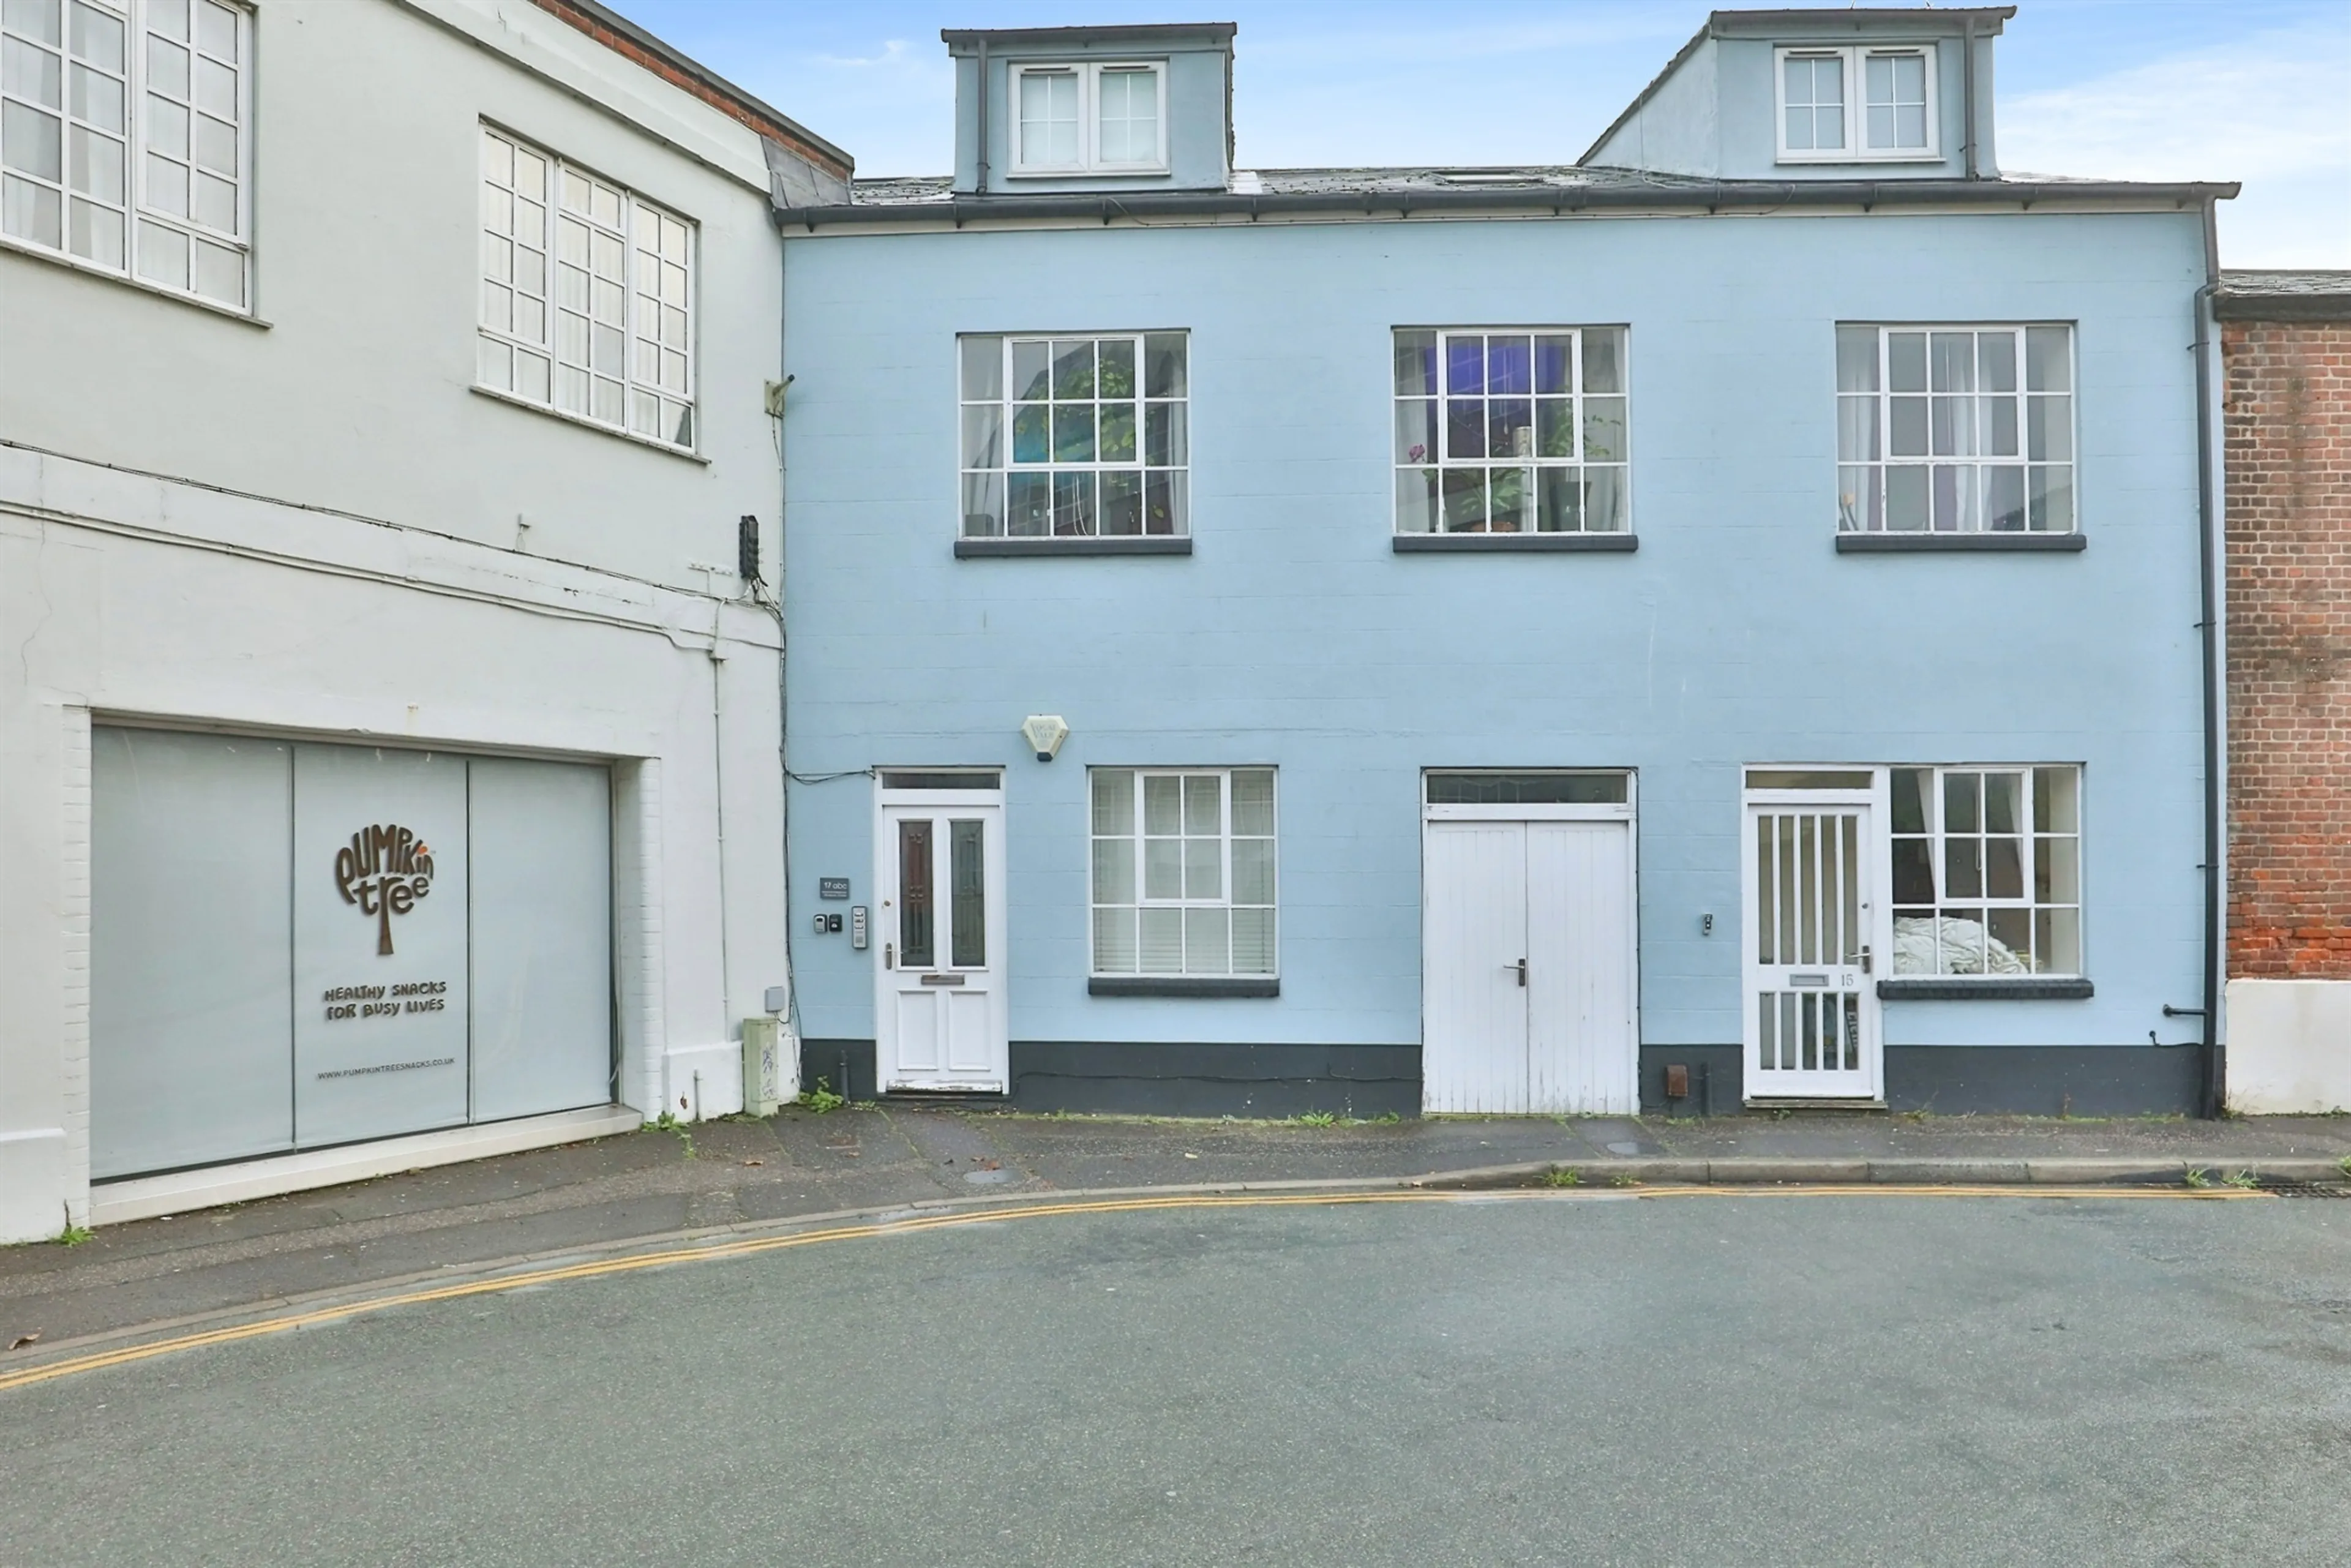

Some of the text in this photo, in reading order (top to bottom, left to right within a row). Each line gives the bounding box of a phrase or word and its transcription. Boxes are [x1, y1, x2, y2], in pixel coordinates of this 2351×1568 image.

[353, 876, 430, 955] tree
[1841, 974, 1854, 986] 15
[324, 981, 447, 1002] HEALTHY SNACKS
[364, 1002, 400, 1017] BUSY
[407, 999, 445, 1013] LIVES
[317, 1057, 456, 1080] WWW.PUMPKINTREESNACKS.CO.UK
